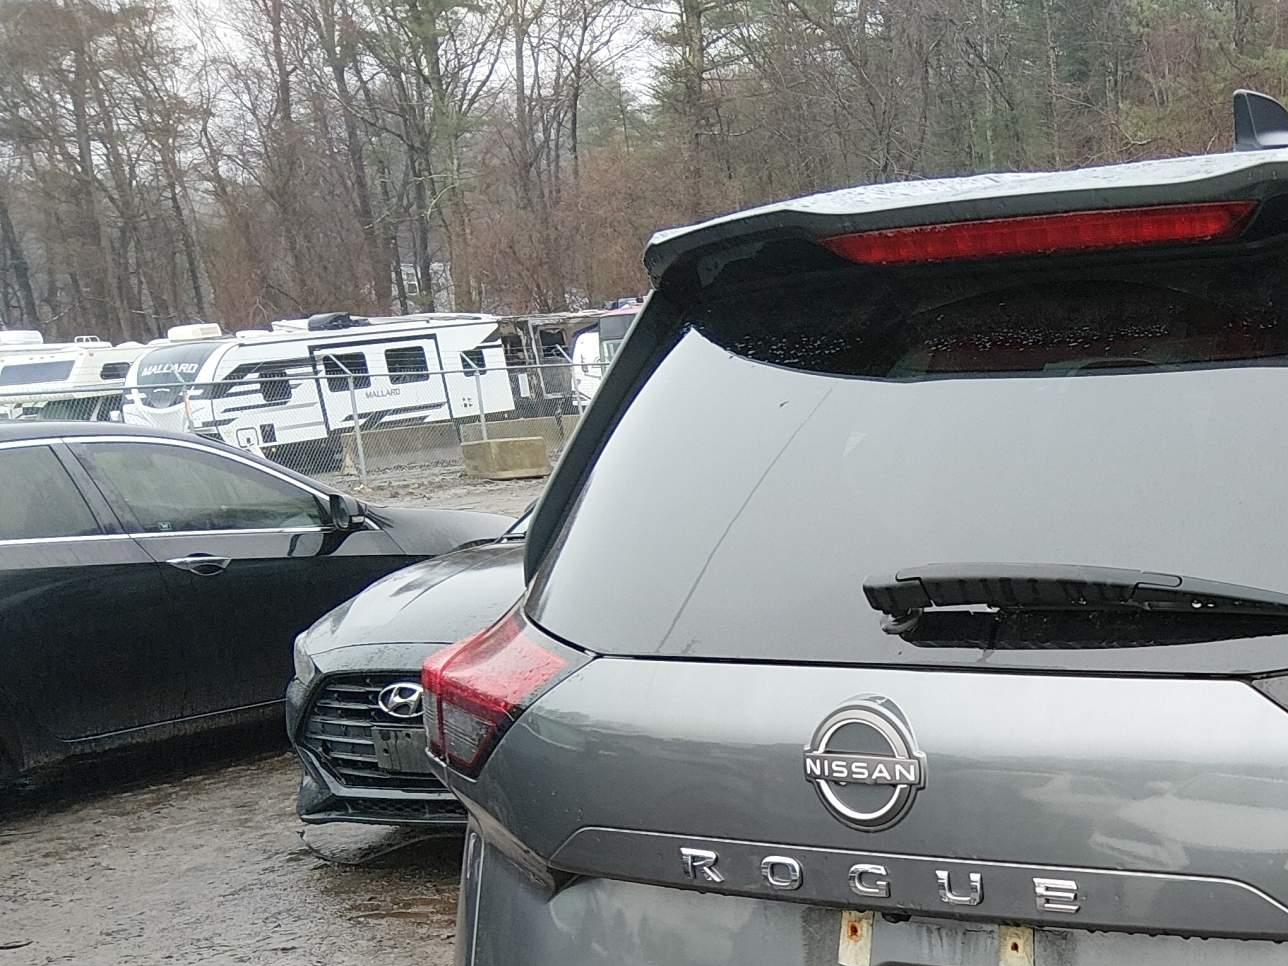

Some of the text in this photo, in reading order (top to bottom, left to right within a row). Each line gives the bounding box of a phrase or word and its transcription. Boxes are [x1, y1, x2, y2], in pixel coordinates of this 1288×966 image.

[142, 363, 199, 377] MALLARD
[805, 757, 916, 781] NISSAN
[680, 847, 1080, 914] ROGUE
